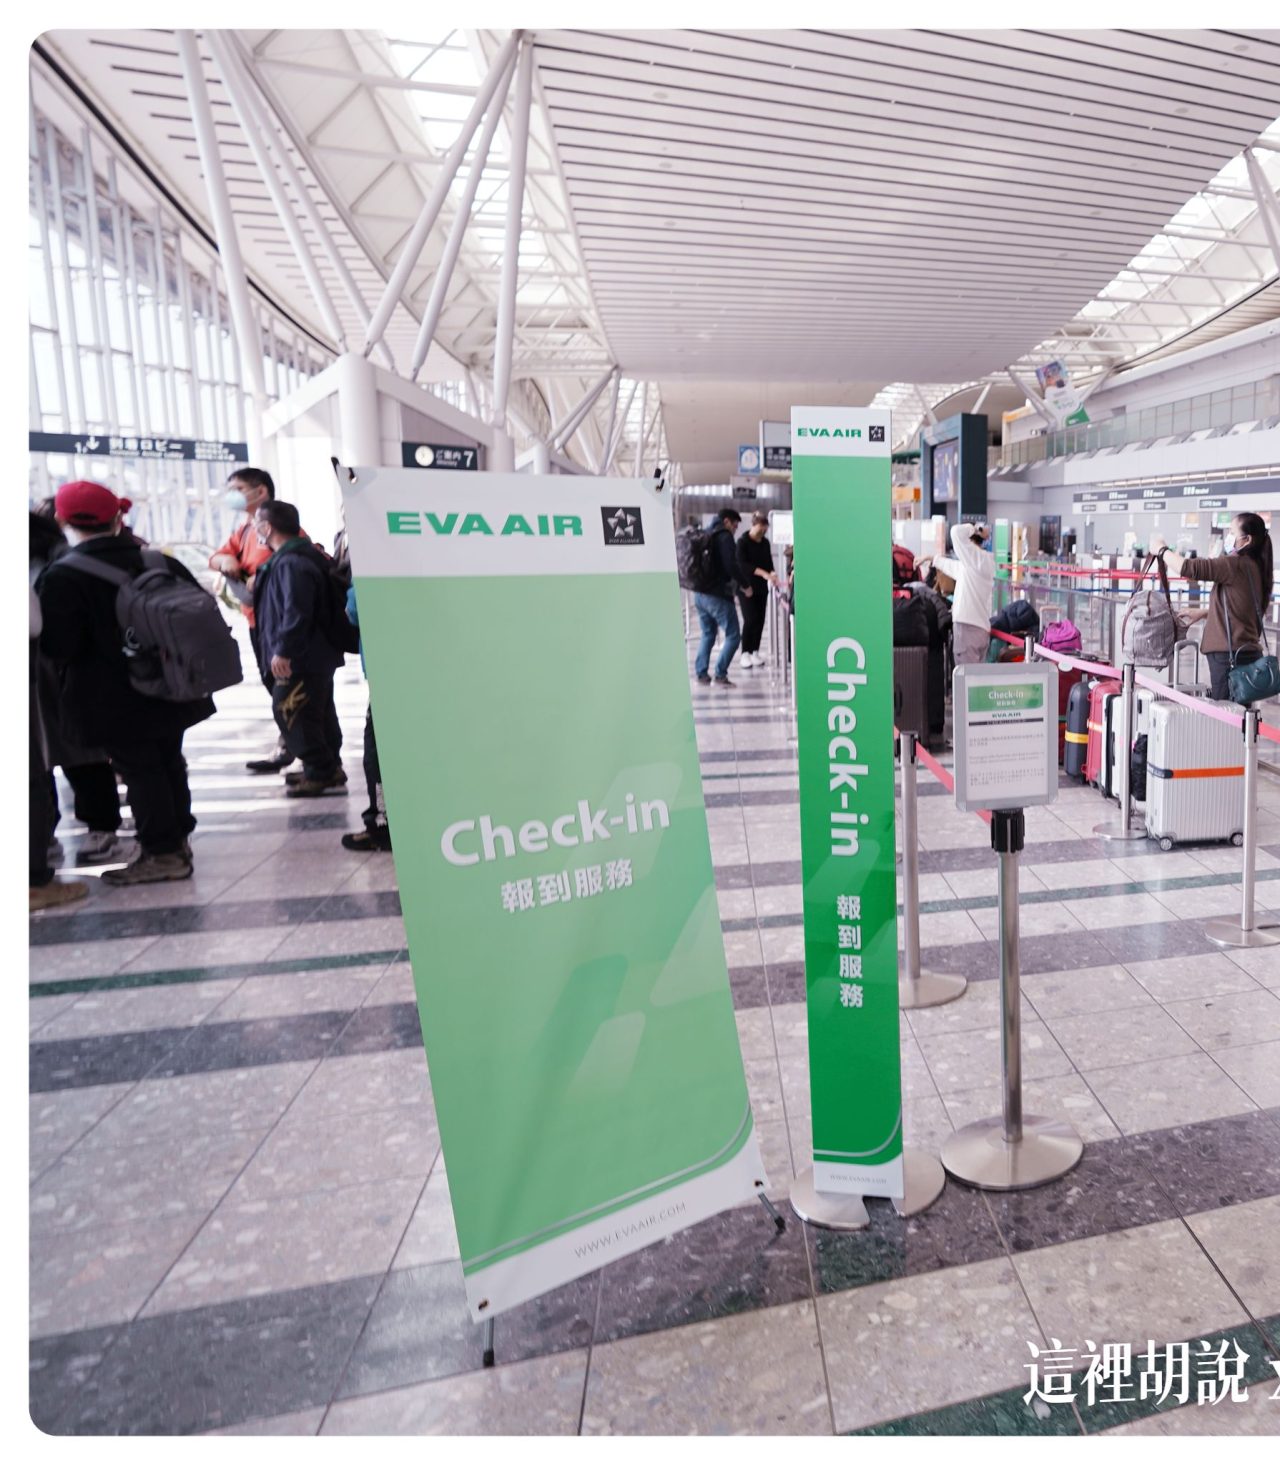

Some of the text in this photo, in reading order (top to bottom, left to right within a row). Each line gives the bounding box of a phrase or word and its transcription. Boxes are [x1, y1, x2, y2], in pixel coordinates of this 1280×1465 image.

[464, 450, 474, 468] 7
[988, 689, 1024, 700] Check-in
[826, 636, 870, 857] Check-in
[440, 792, 671, 866] Check-in
[501, 858, 633, 913] 報到服務
[836, 895, 864, 1009] 報到服務
[574, 1202, 687, 1259] WWW.EVAAIR.COM
